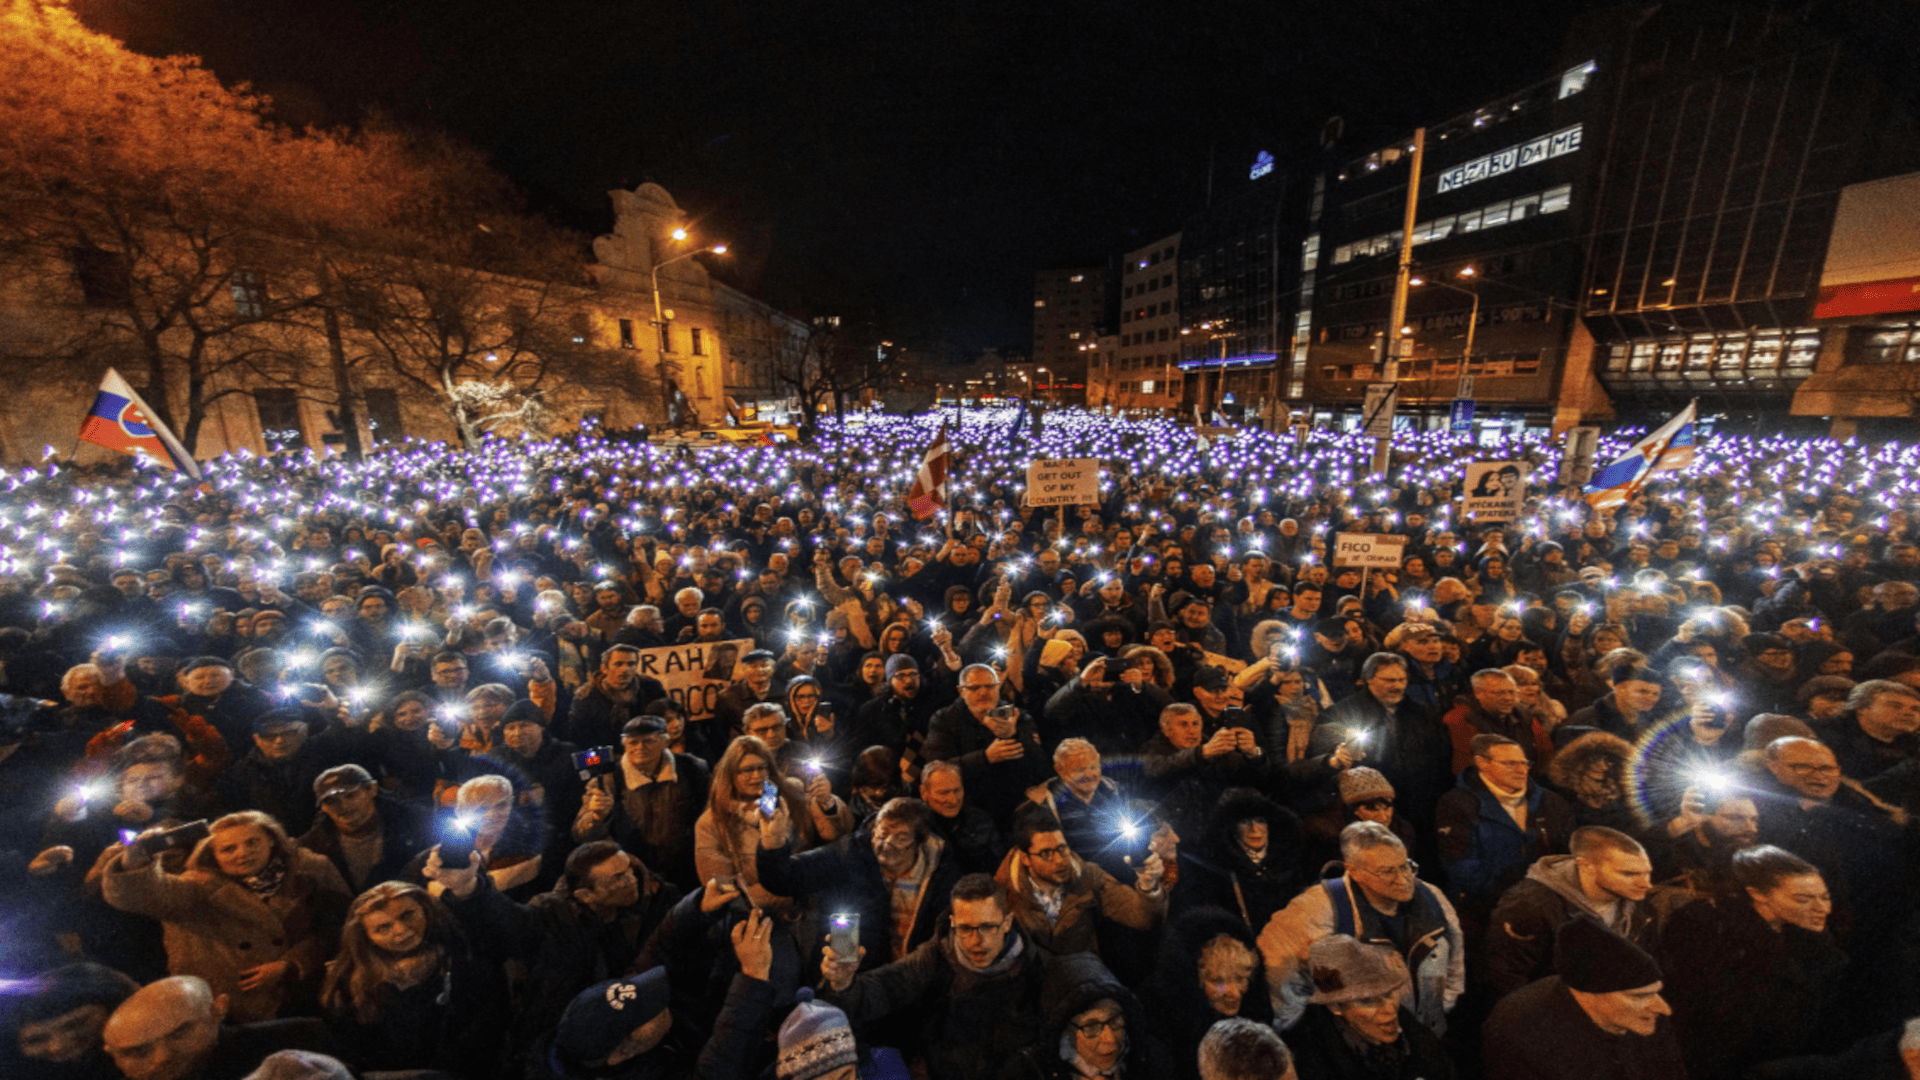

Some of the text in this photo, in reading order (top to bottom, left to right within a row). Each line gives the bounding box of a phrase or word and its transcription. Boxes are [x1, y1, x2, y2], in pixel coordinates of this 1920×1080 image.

[1043, 460, 1075, 468] MAFIA
[1037, 471, 1082, 481] GET OUT
[1043, 483, 1076, 493] OF MY
[1029, 495, 1076, 505] COUNTRY
[1341, 542, 1371, 552] FICO
